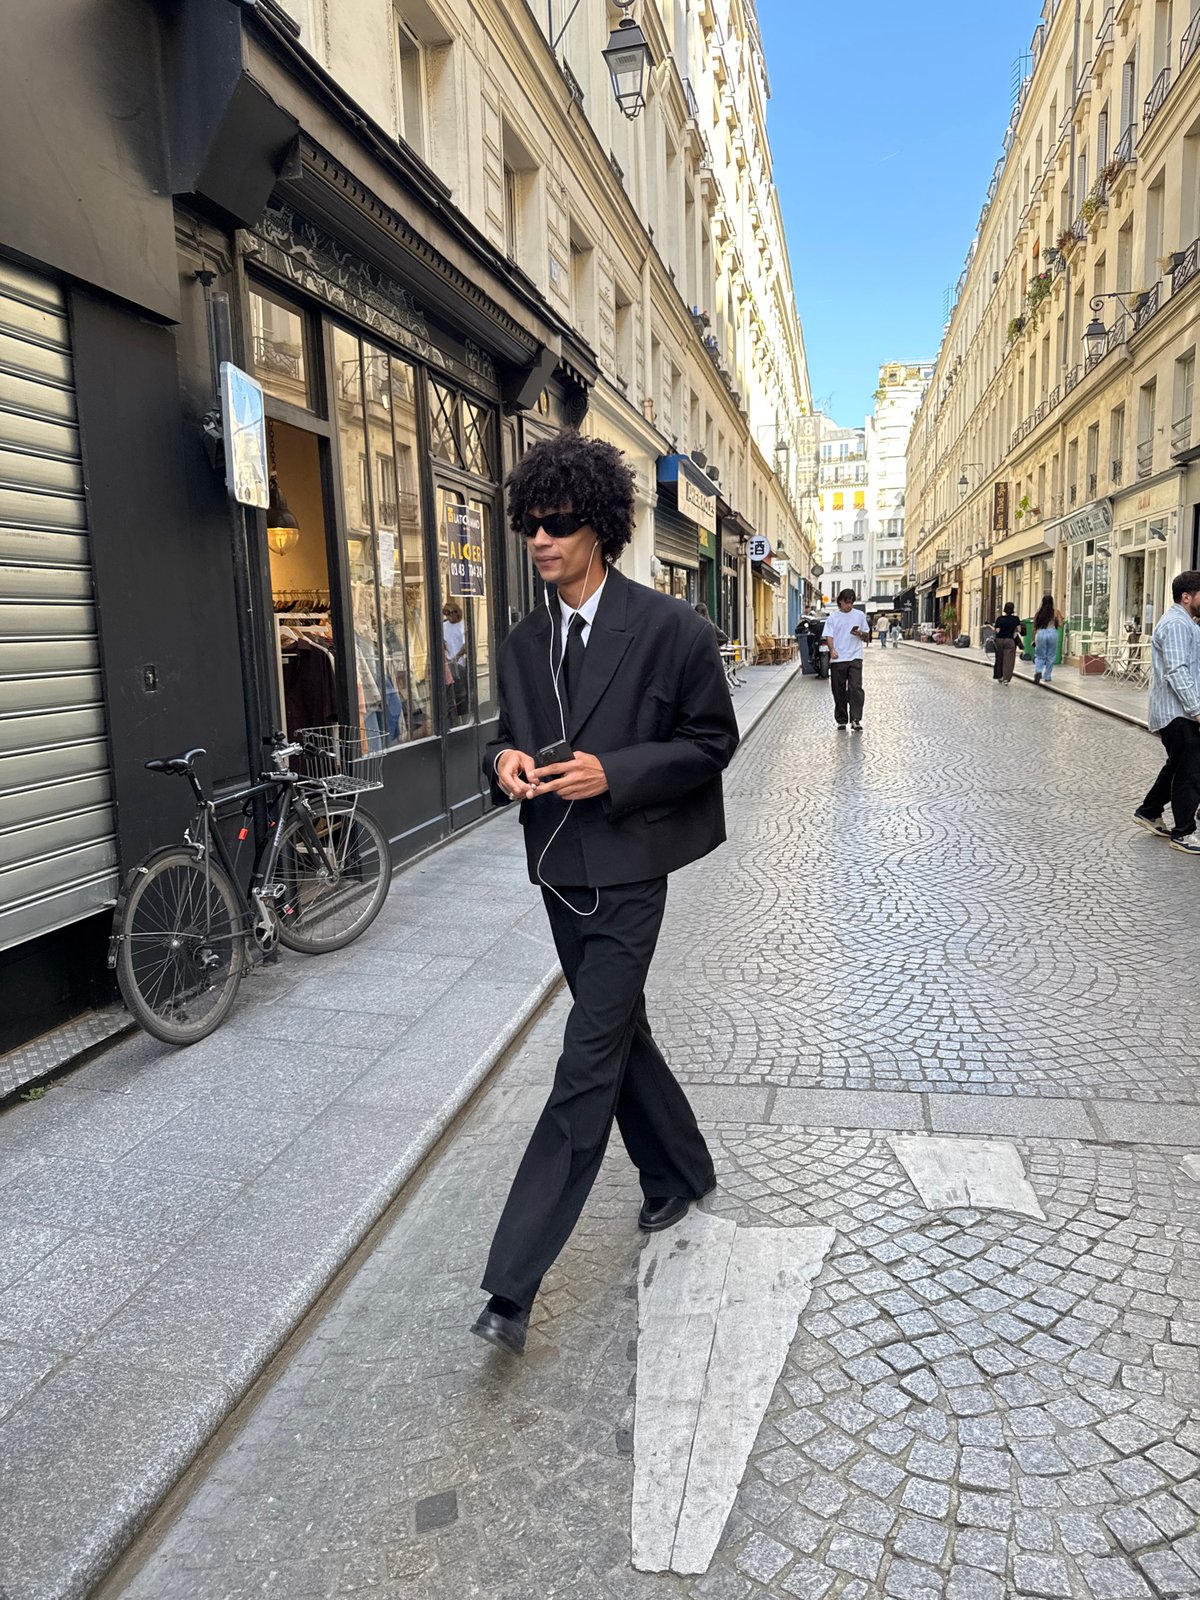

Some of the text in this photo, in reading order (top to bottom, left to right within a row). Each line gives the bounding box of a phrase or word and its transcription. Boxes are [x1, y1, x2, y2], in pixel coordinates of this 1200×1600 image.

[1067, 516, 1093, 539] LAVERIE
[450, 541, 482, 562] A LOER
[750, 540, 765, 556] 酒
